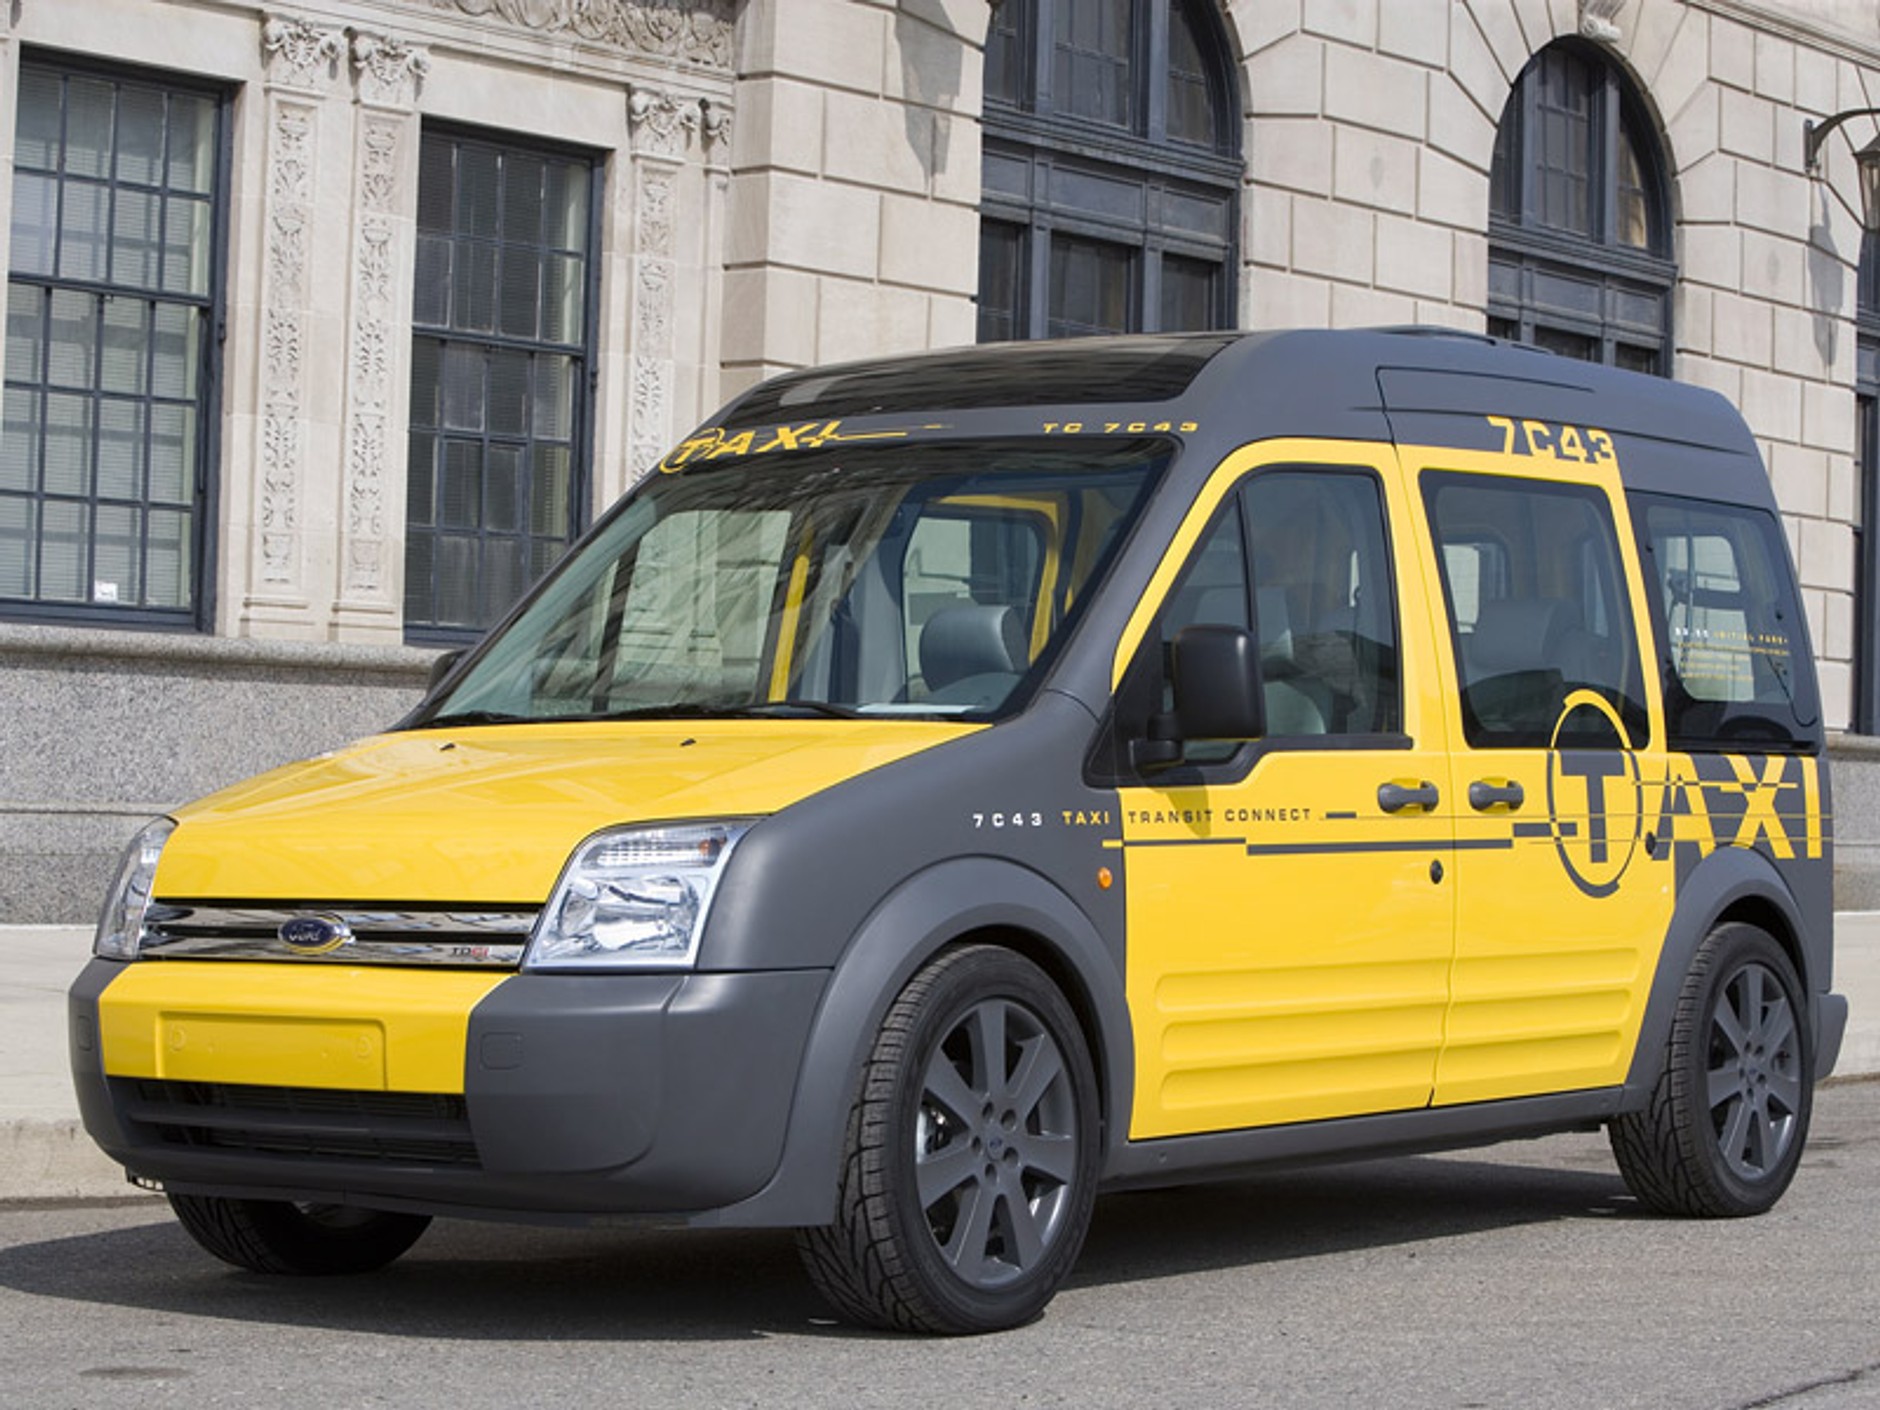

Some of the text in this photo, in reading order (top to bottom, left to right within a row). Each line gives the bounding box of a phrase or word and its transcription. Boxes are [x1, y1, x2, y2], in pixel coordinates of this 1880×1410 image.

[670, 420, 842, 466] TAXI
[1486, 414, 1618, 464] 7C43
[972, 808, 1313, 828] 7C43 TAXI TRANSIT CONNECT
[1560, 750, 1822, 864] TAXI
